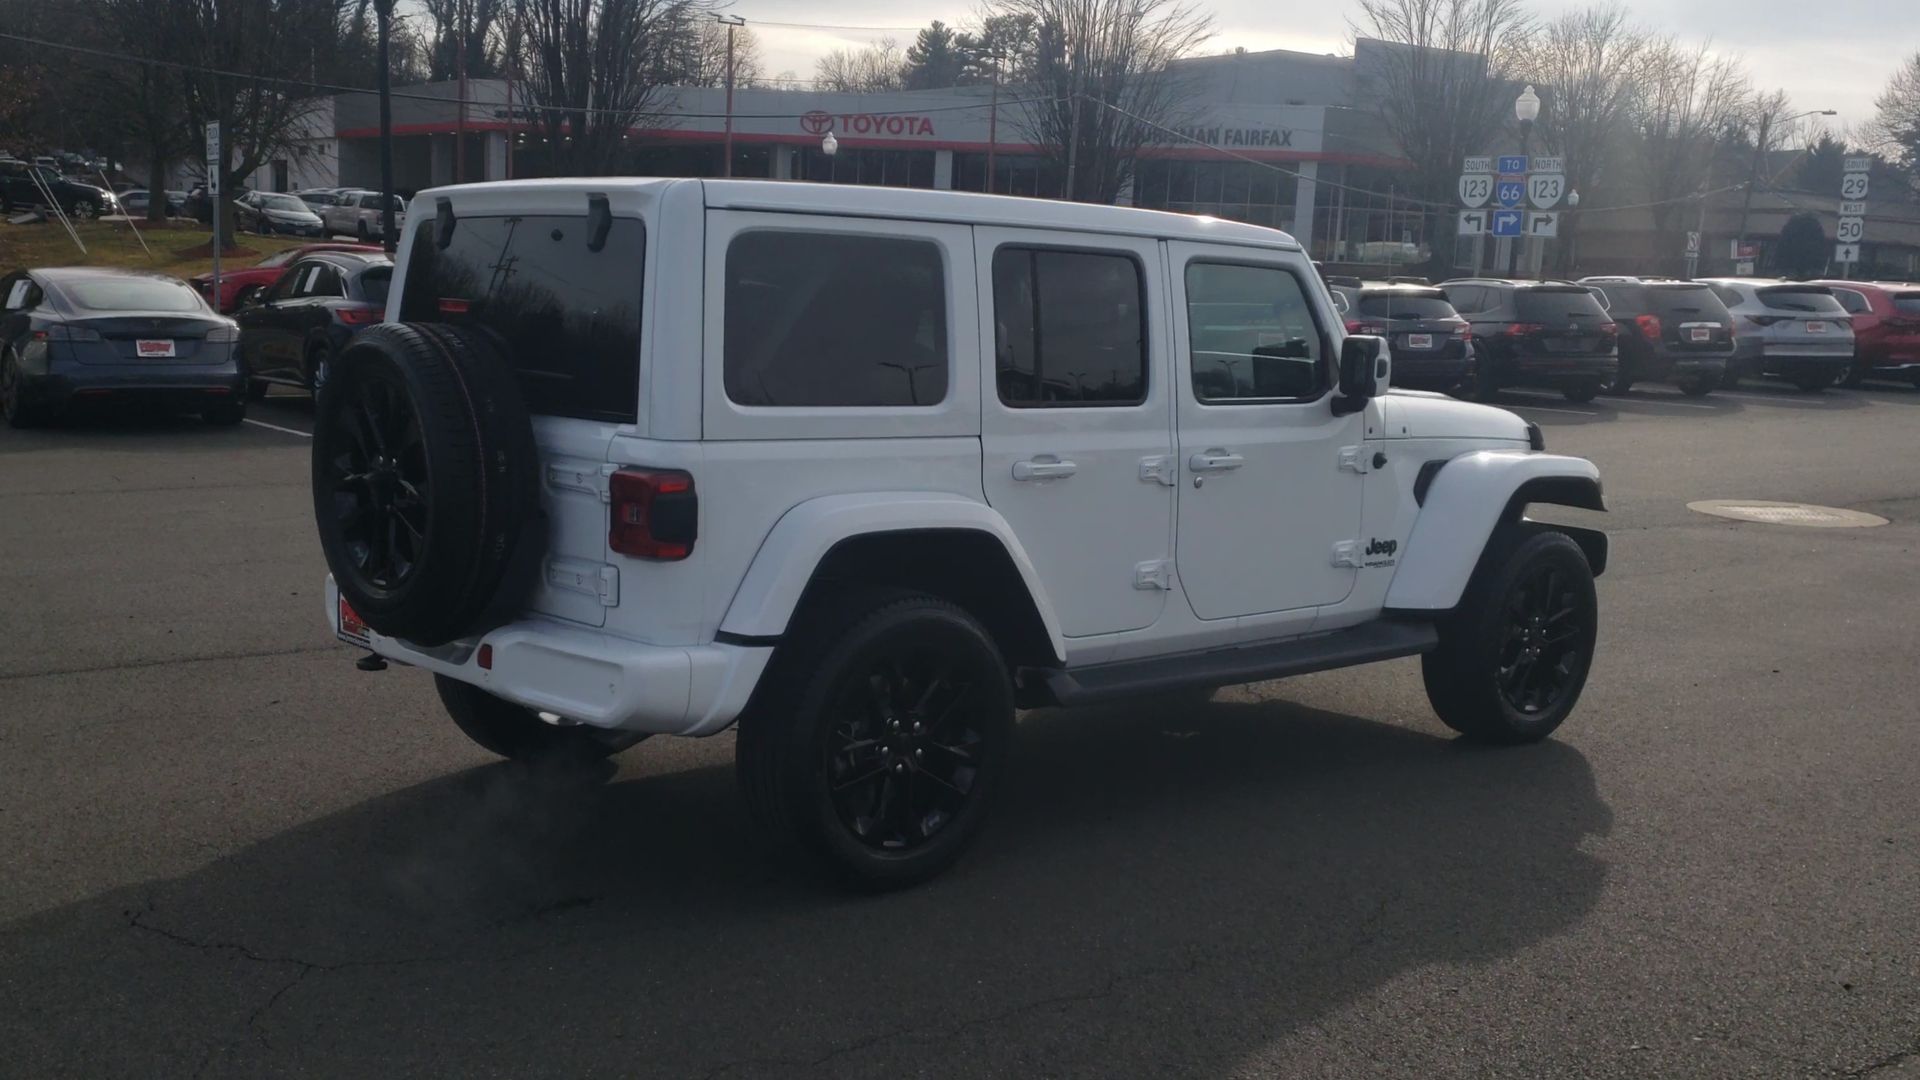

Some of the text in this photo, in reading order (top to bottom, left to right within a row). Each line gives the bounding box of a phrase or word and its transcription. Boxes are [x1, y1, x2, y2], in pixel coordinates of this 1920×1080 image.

[840, 114, 935, 136] TOYOTA
[1224, 128, 1293, 147] FAIRFAX
[1465, 160, 1490, 170] SOUTH
[1506, 160, 1520, 170] TO
[1535, 159, 1561, 170] NORTH
[1463, 180, 1488, 198] 123
[1501, 185, 1520, 200] 66
[1533, 180, 1559, 199] 123
[1844, 179, 1866, 194] 29
[1839, 222, 1860, 237] 50
[1365, 537, 1397, 557] Jeep
